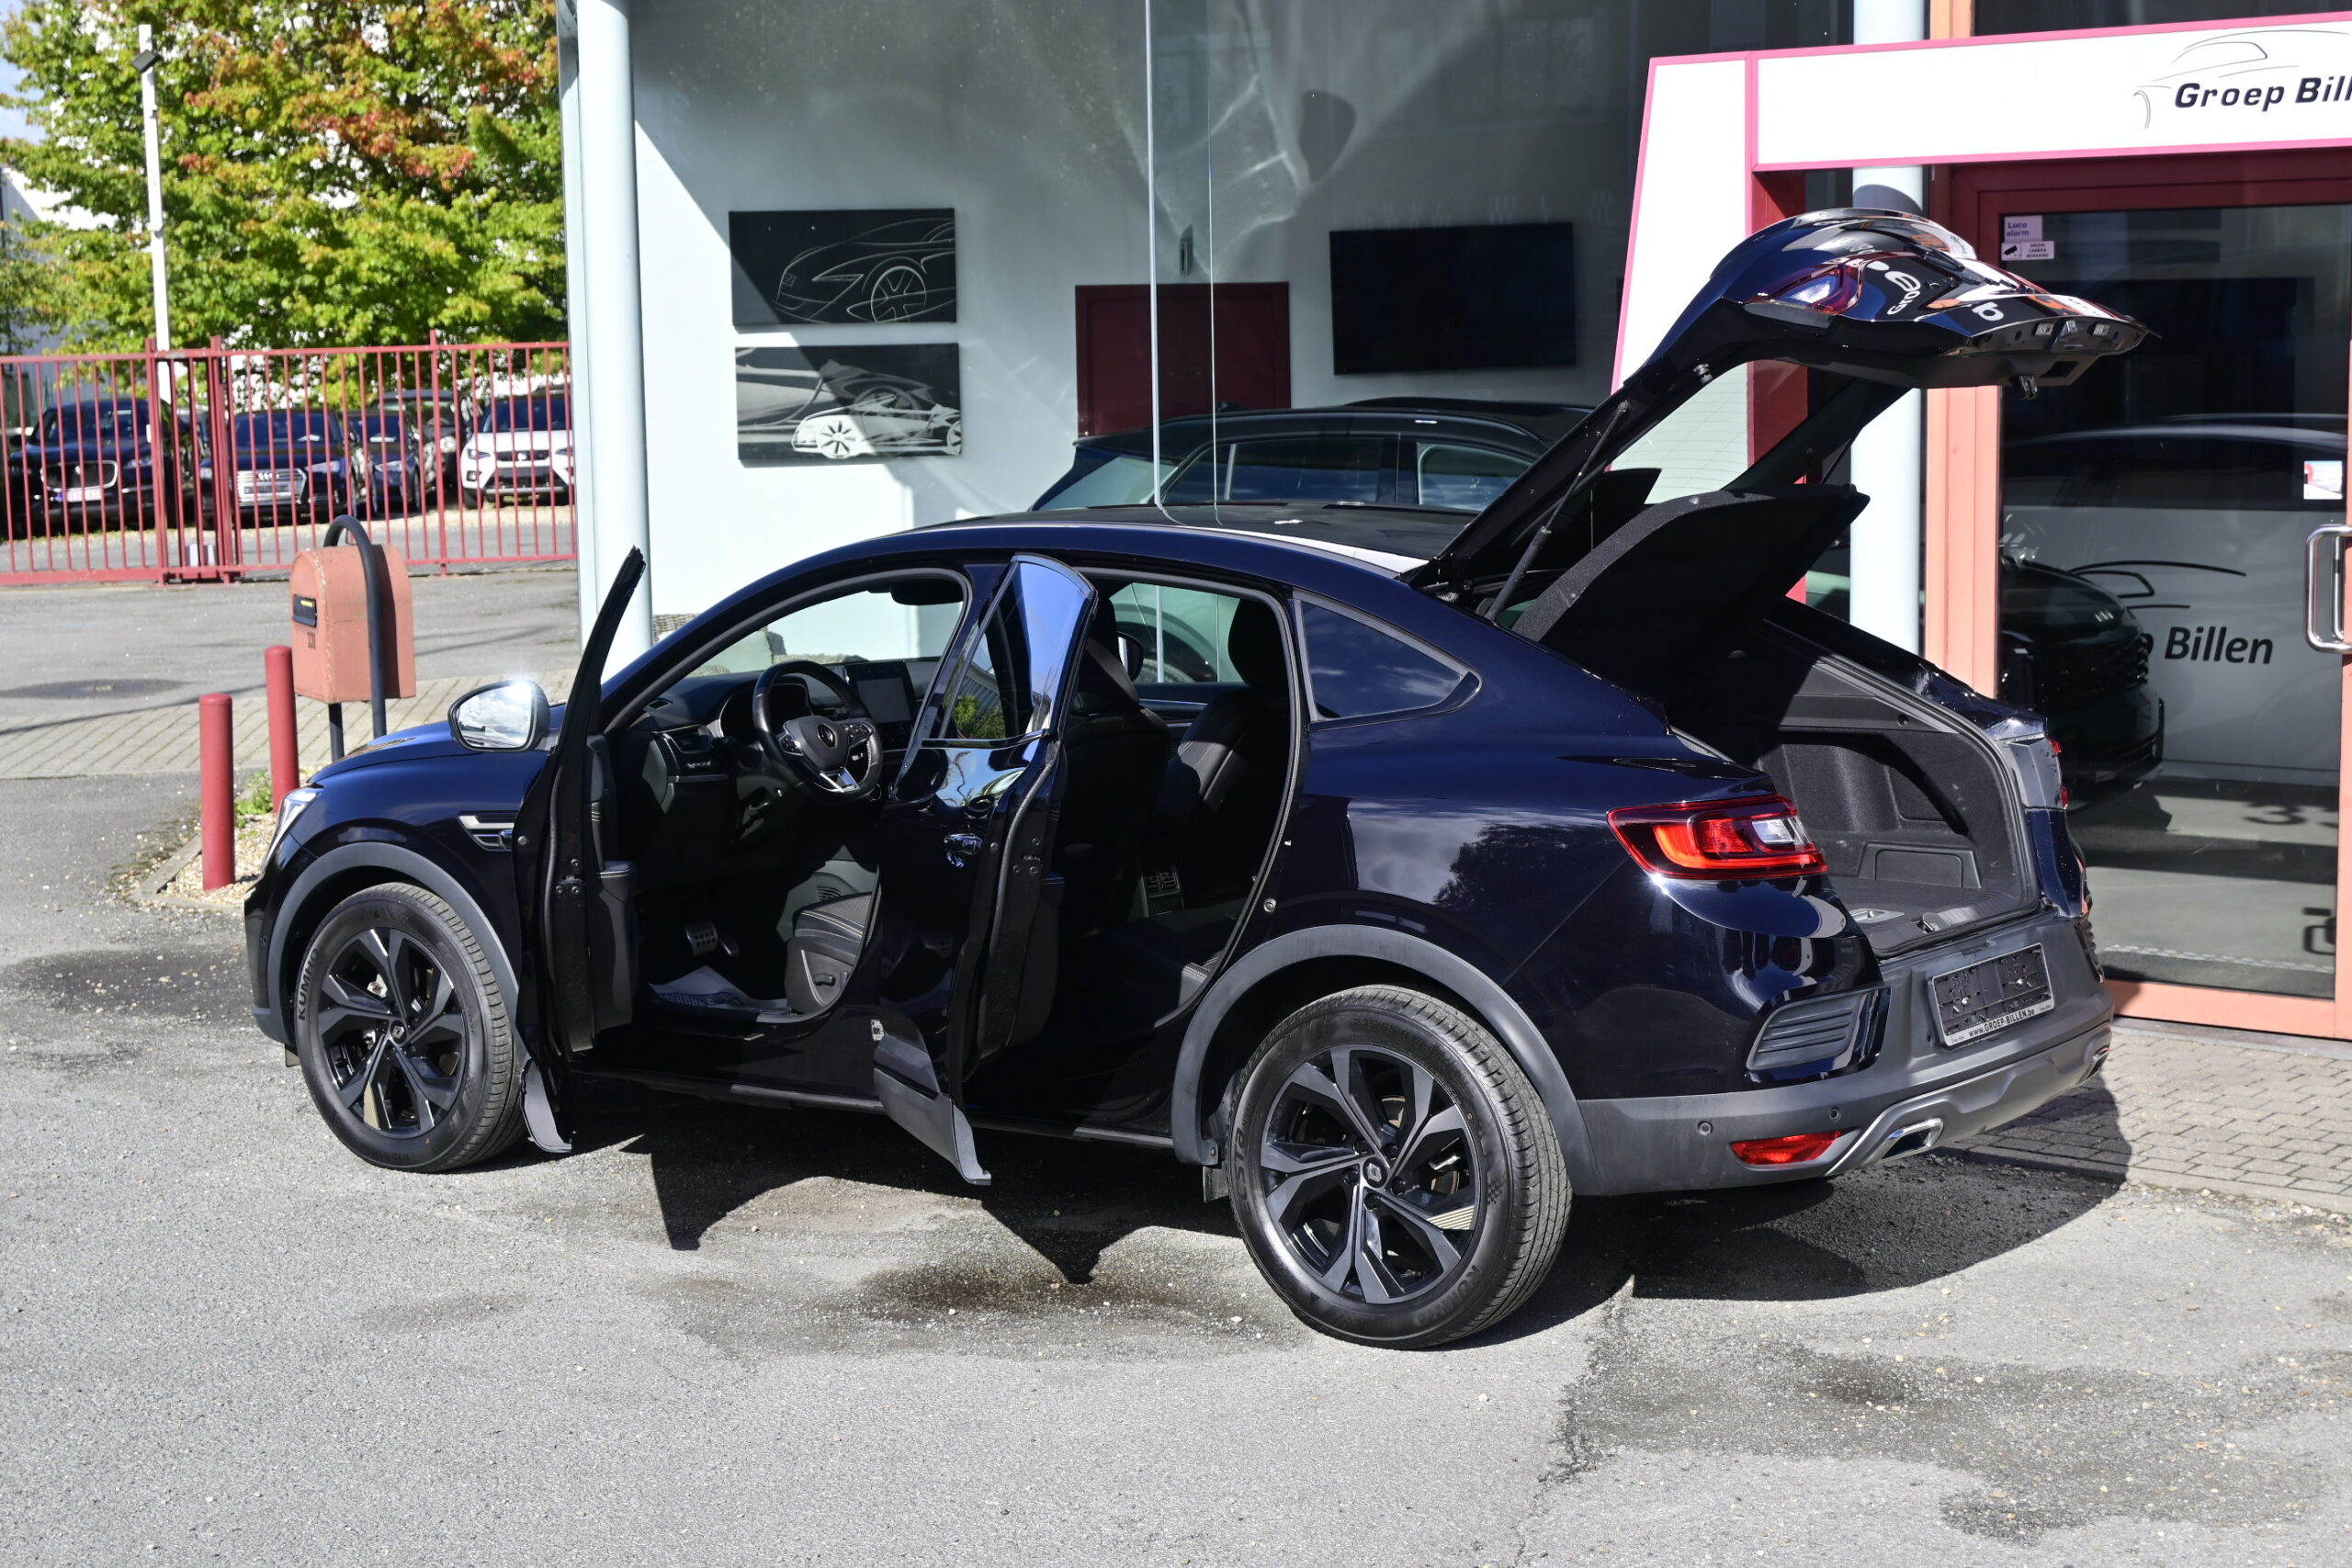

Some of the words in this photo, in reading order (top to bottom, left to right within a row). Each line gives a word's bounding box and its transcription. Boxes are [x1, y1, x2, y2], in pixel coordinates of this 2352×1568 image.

[2175, 83, 2285, 112] Groep
[2165, 626, 2273, 664] Billen
[298, 948, 318, 1021] KUMHO
[1969, 1009, 2035, 1037] www.GROEP-BILLEN.be
[1413, 1265, 1483, 1326] KUMHO
